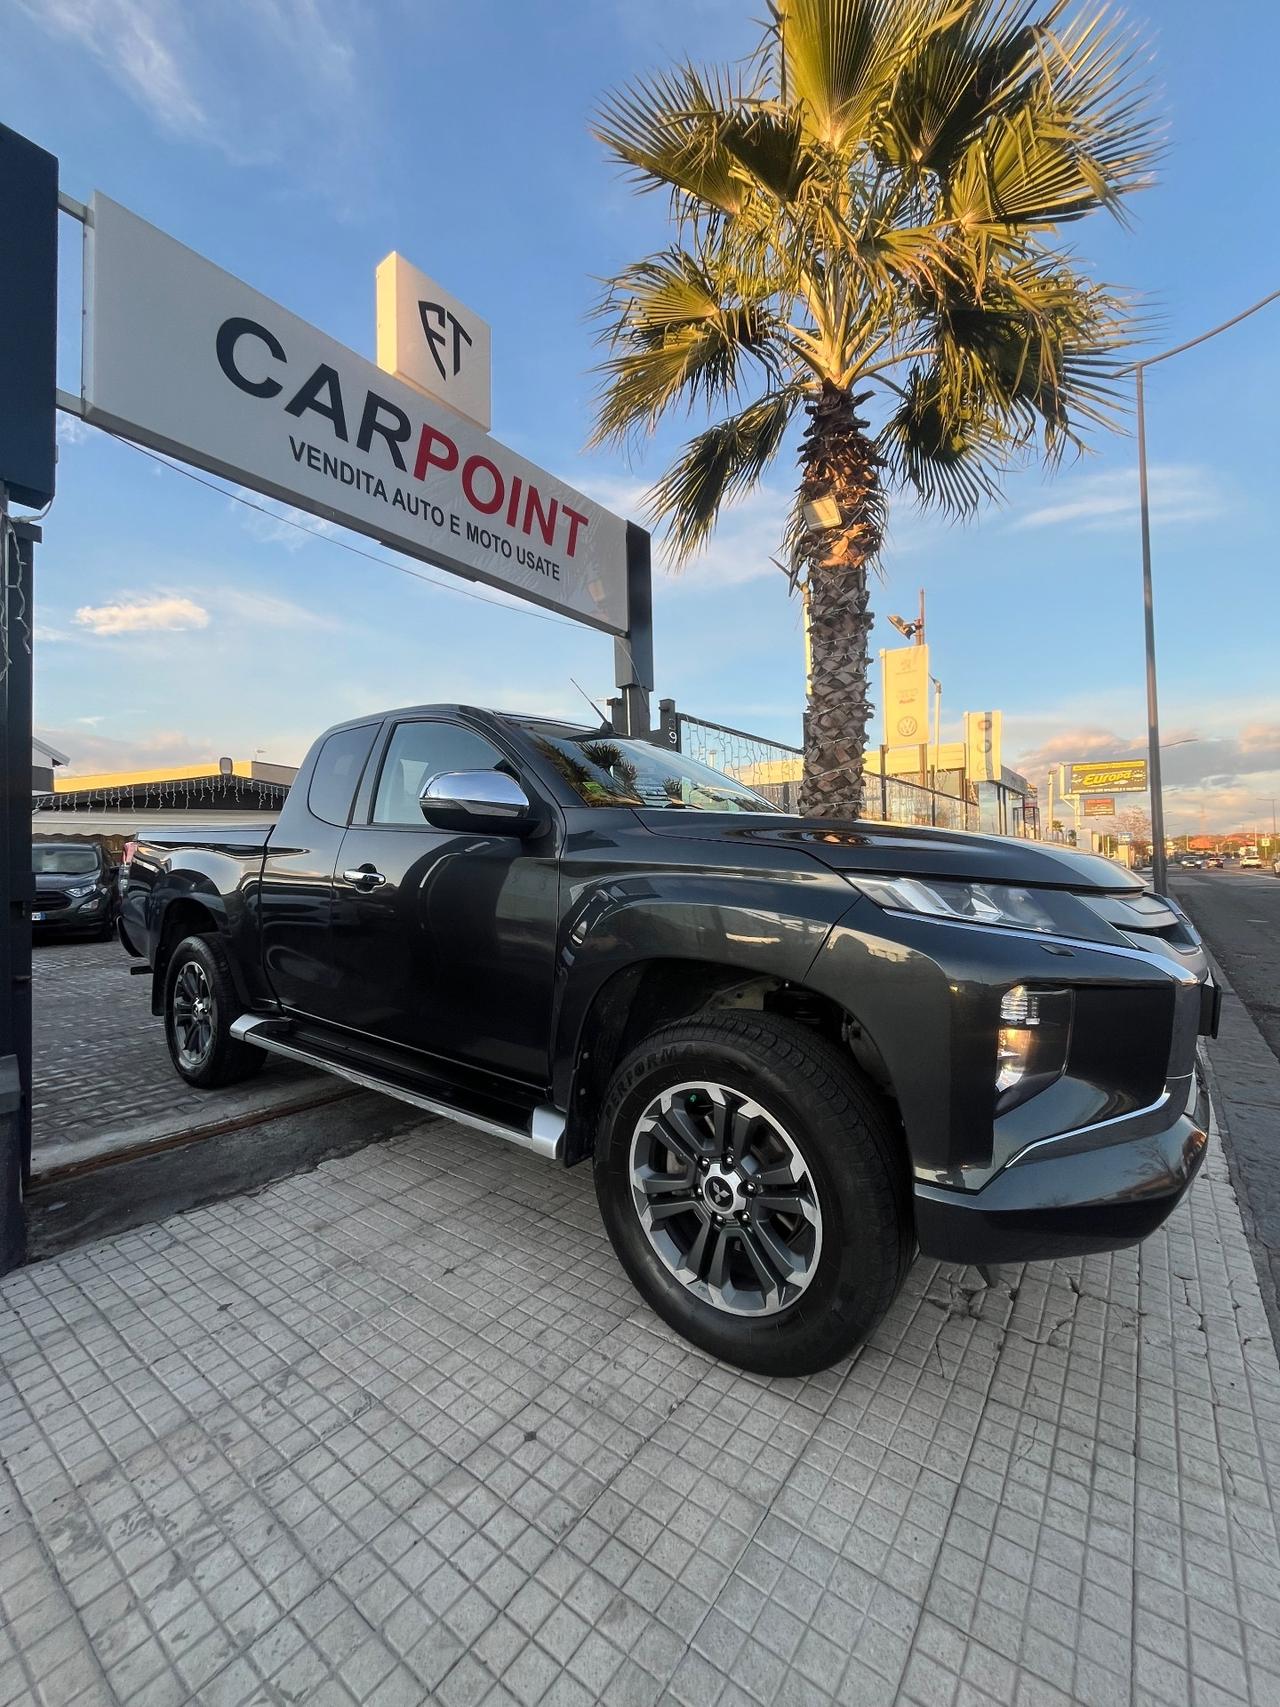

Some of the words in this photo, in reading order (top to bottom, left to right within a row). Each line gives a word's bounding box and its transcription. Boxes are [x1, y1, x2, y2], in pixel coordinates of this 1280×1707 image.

[216, 317, 589, 558] CARPOINT
[289, 435, 388, 503] VENDITA
[392, 488, 444, 527] AUTO
[450, 513, 461, 536] E
[466, 521, 512, 558] MOTO
[516, 546, 560, 581] USATE
[1082, 769, 1133, 787] Europa
